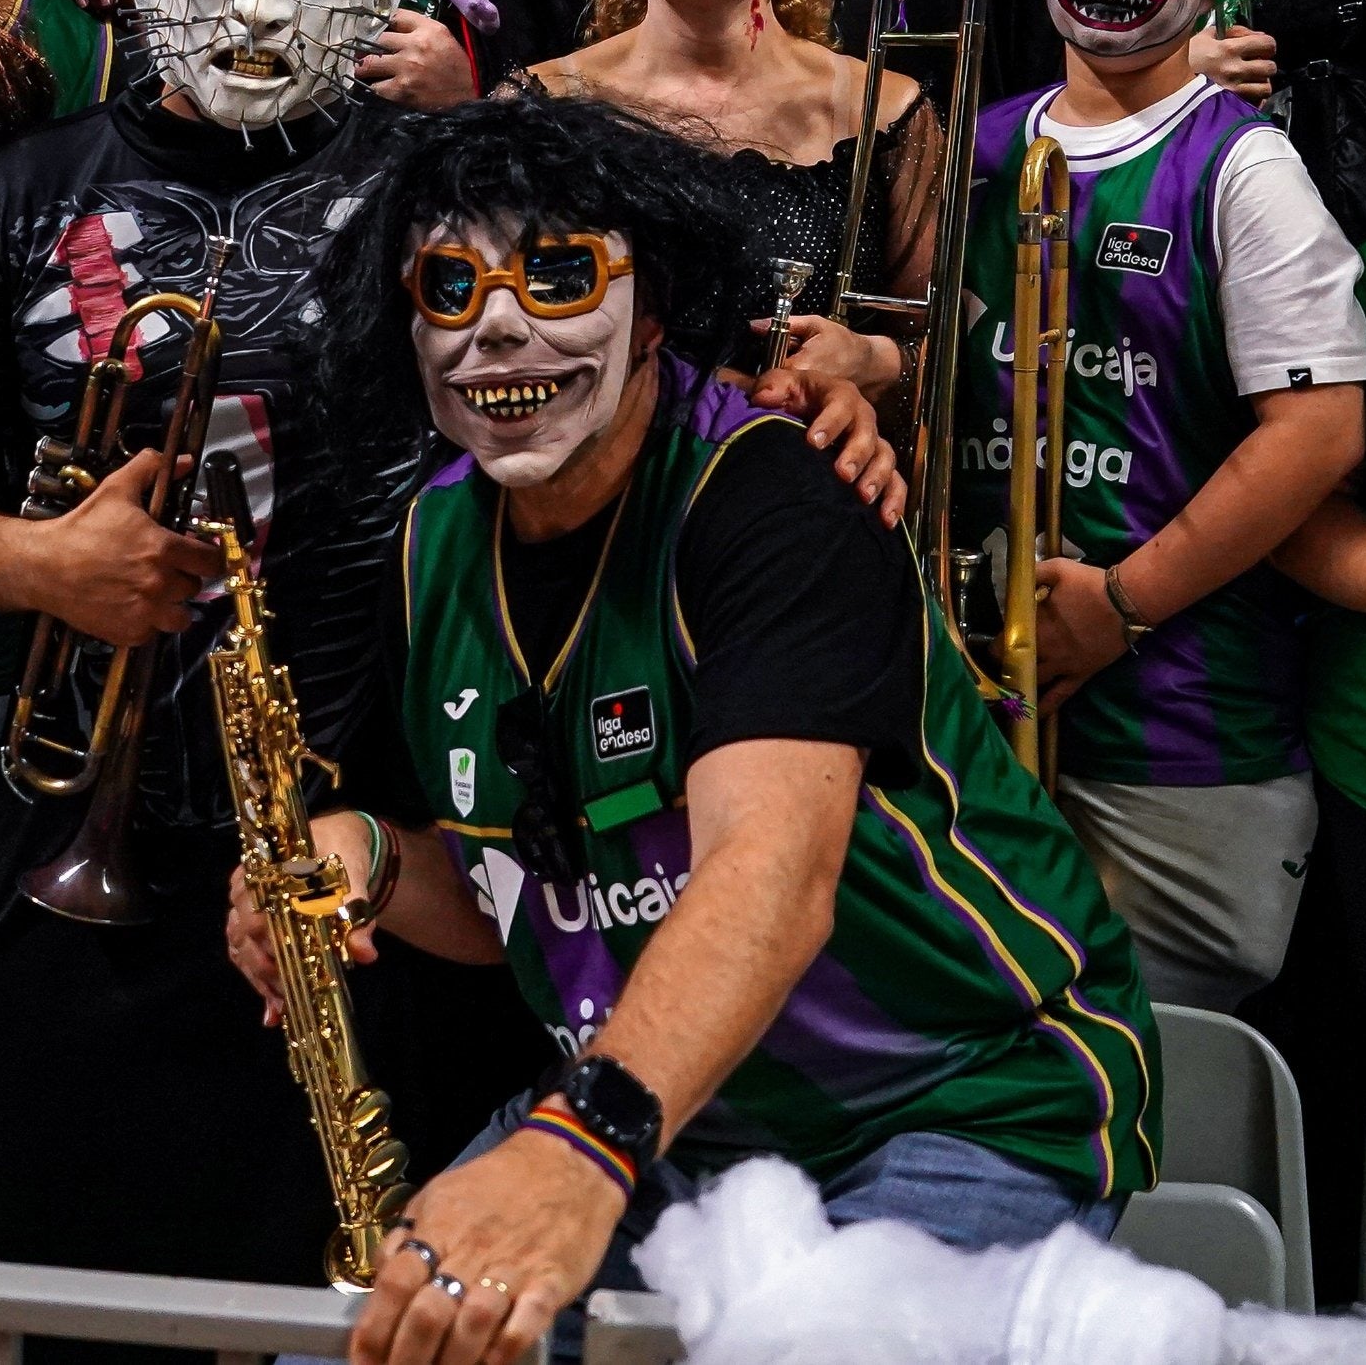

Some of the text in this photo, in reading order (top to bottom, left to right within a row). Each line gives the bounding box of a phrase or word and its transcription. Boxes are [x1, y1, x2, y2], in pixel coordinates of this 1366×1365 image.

[1107, 237, 1133, 251] liga
[1104, 252, 1159, 269] endesa
[597, 716, 622, 736] liga
[600, 727, 650, 752] endesa
